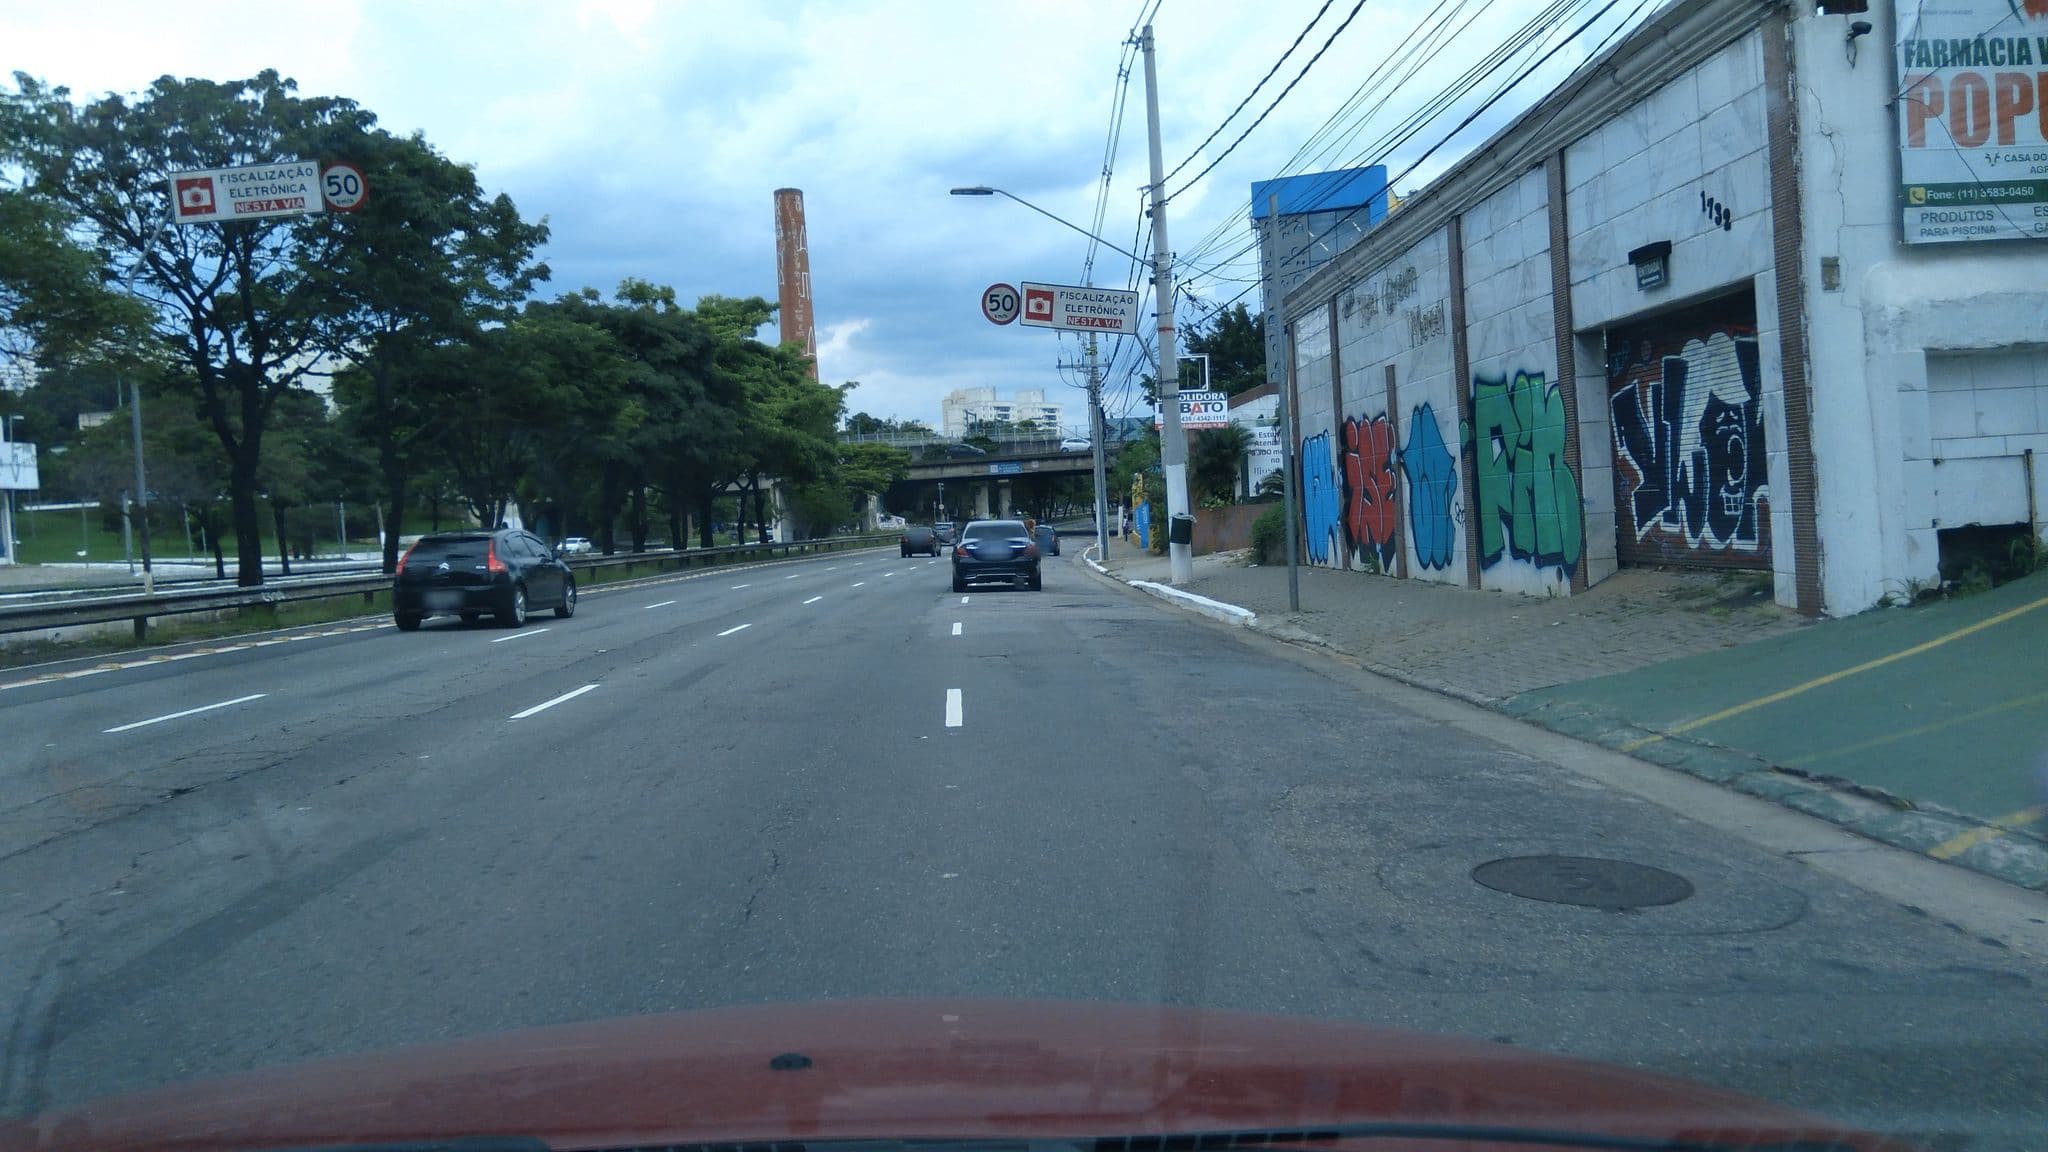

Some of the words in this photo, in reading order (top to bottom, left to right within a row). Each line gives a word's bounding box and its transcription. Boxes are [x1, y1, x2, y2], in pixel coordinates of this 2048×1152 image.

[1904, 33, 2033, 67] FARMÁCIA
[2004, 153, 2031, 162] CASA
[2033, 153, 2048, 162] DO
[219, 167, 313, 184] FISCALIZAÇÃO
[229, 183, 307, 198] ELETRÔNICA
[327, 174, 358, 197] 50
[1927, 190, 1955, 200] Fone:
[1958, 188, 1978, 201] (11)
[235, 200, 279, 214] NESTA
[284, 197, 305, 210] VIA
[1921, 210, 1995, 224] PRODUTOS
[1920, 227, 1949, 237] PARA
[1952, 225, 1997, 236] PISCINA
[989, 294, 1014, 312] 50
[1059, 291, 1134, 305] FISCALIZAÇÃO
[1065, 303, 1127, 316] ELETRÔNICA
[1067, 316, 1101, 327] NESTA
[1105, 319, 1122, 328] VIA
[1179, 392, 1226, 402] OLIDORA
